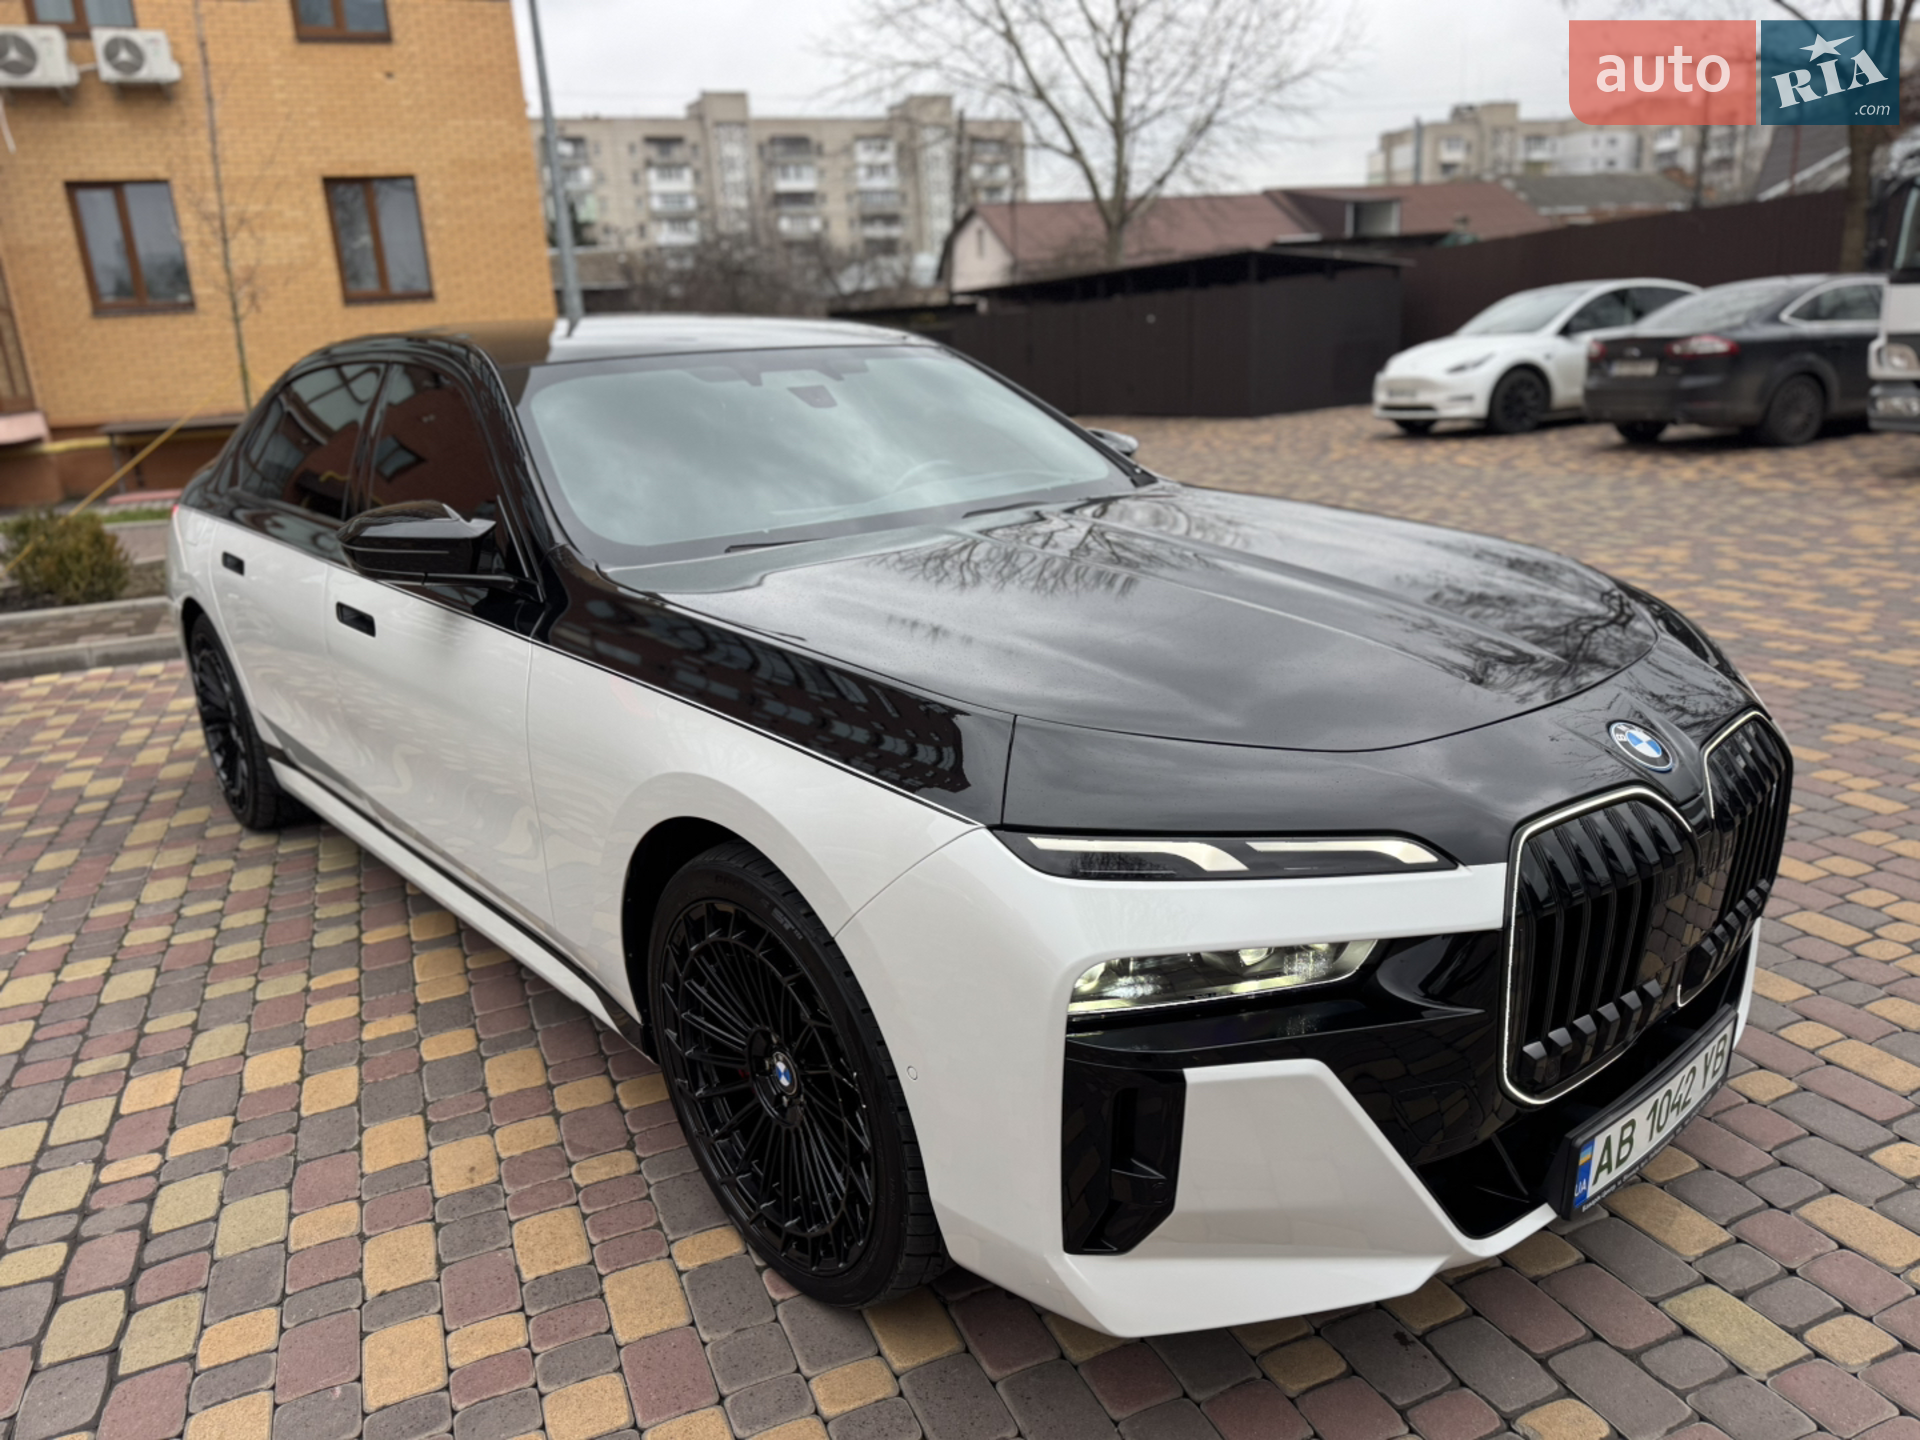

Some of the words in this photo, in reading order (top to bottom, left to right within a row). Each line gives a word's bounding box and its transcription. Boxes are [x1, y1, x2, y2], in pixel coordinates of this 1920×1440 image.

[1592, 1118, 1637, 1187] AB
[1646, 1065, 1697, 1143] 1042
[1702, 1033, 1728, 1091] YB
[1574, 1178, 1588, 1198] UA
